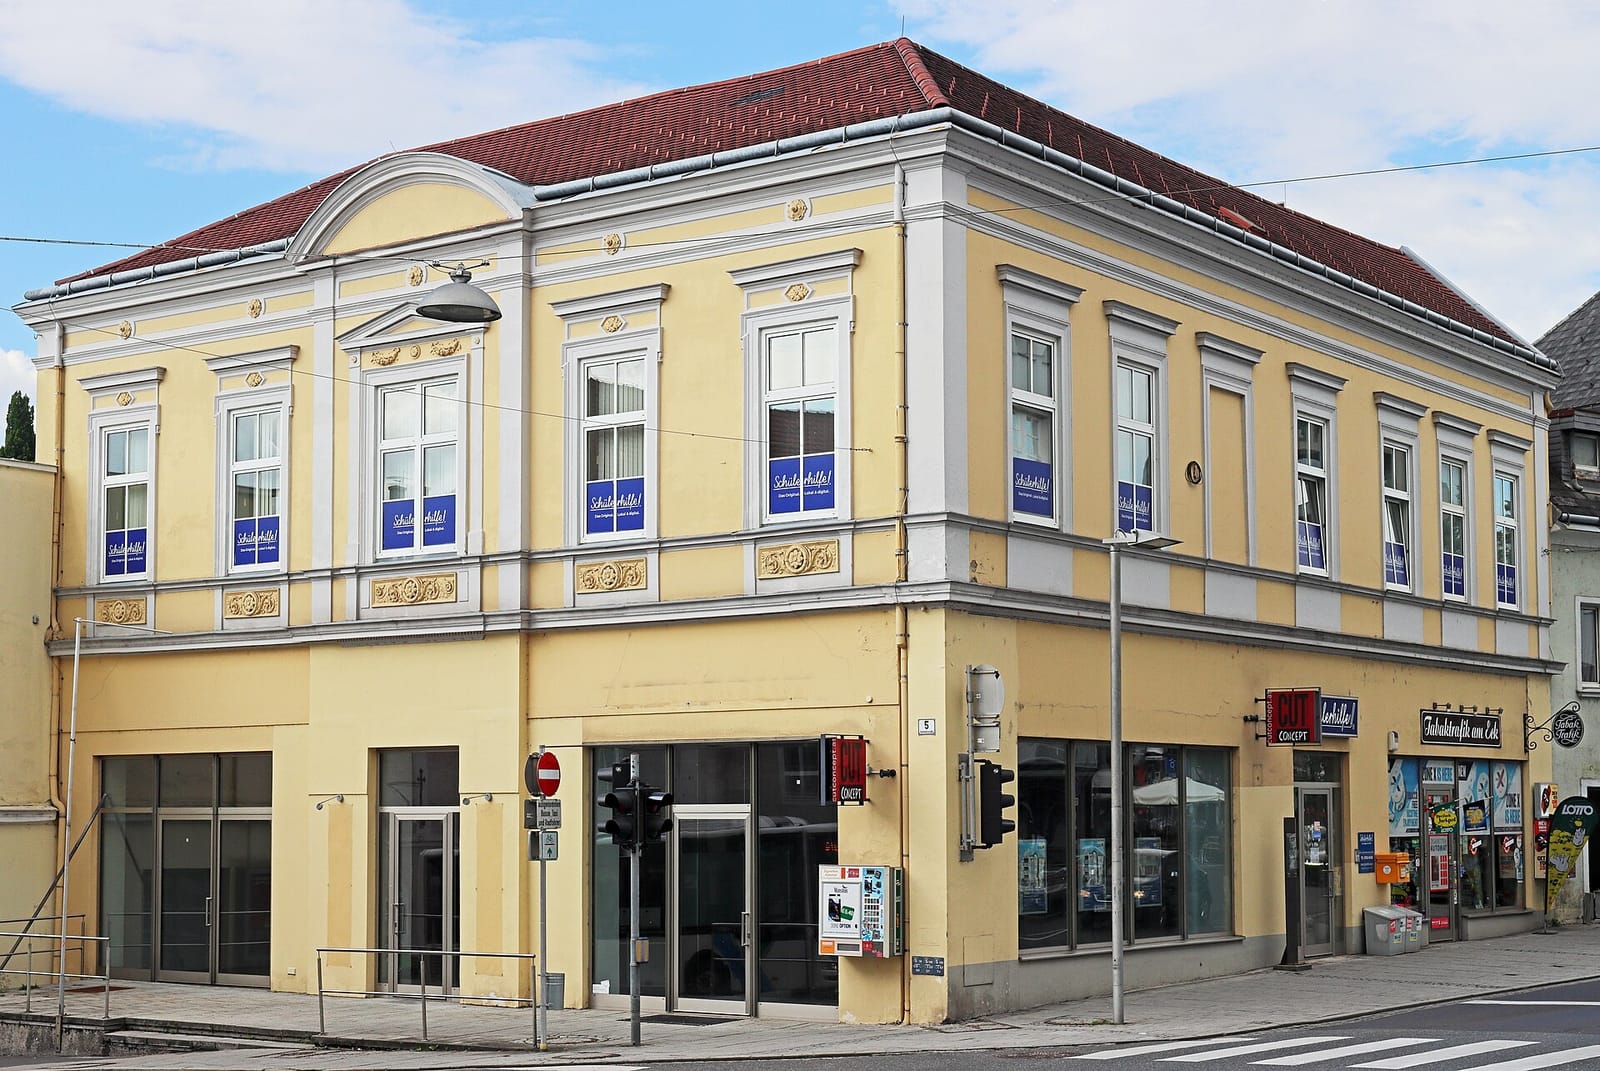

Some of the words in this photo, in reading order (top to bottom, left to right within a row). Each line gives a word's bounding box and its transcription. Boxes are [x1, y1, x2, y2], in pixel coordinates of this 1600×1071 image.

[773, 470, 832, 490] Schülerhilfe!
[1015, 473, 1050, 493] Schülerhilfe!
[590, 492, 642, 511] Schülerhilfe!
[393, 509, 447, 527] Schülerhilfe!
[236, 529, 278, 545] Schülerhilfe!
[108, 541, 146, 556] Schülerhilfe!
[1278, 693, 1309, 727] CUT
[924, 720, 930, 730] 5
[1424, 715, 1471, 742] Tabaktrafik
[1471, 727, 1484, 739] am
[1485, 720, 1499, 740] Eck
[1555, 717, 1580, 730] Tabak
[1278, 730, 1309, 742] CONCEPT
[1555, 729, 1580, 740] Trafik
[841, 742, 862, 782] CUT
[840, 786, 862, 800] CONCEPT
[1561, 804, 1594, 816] LOTTO
